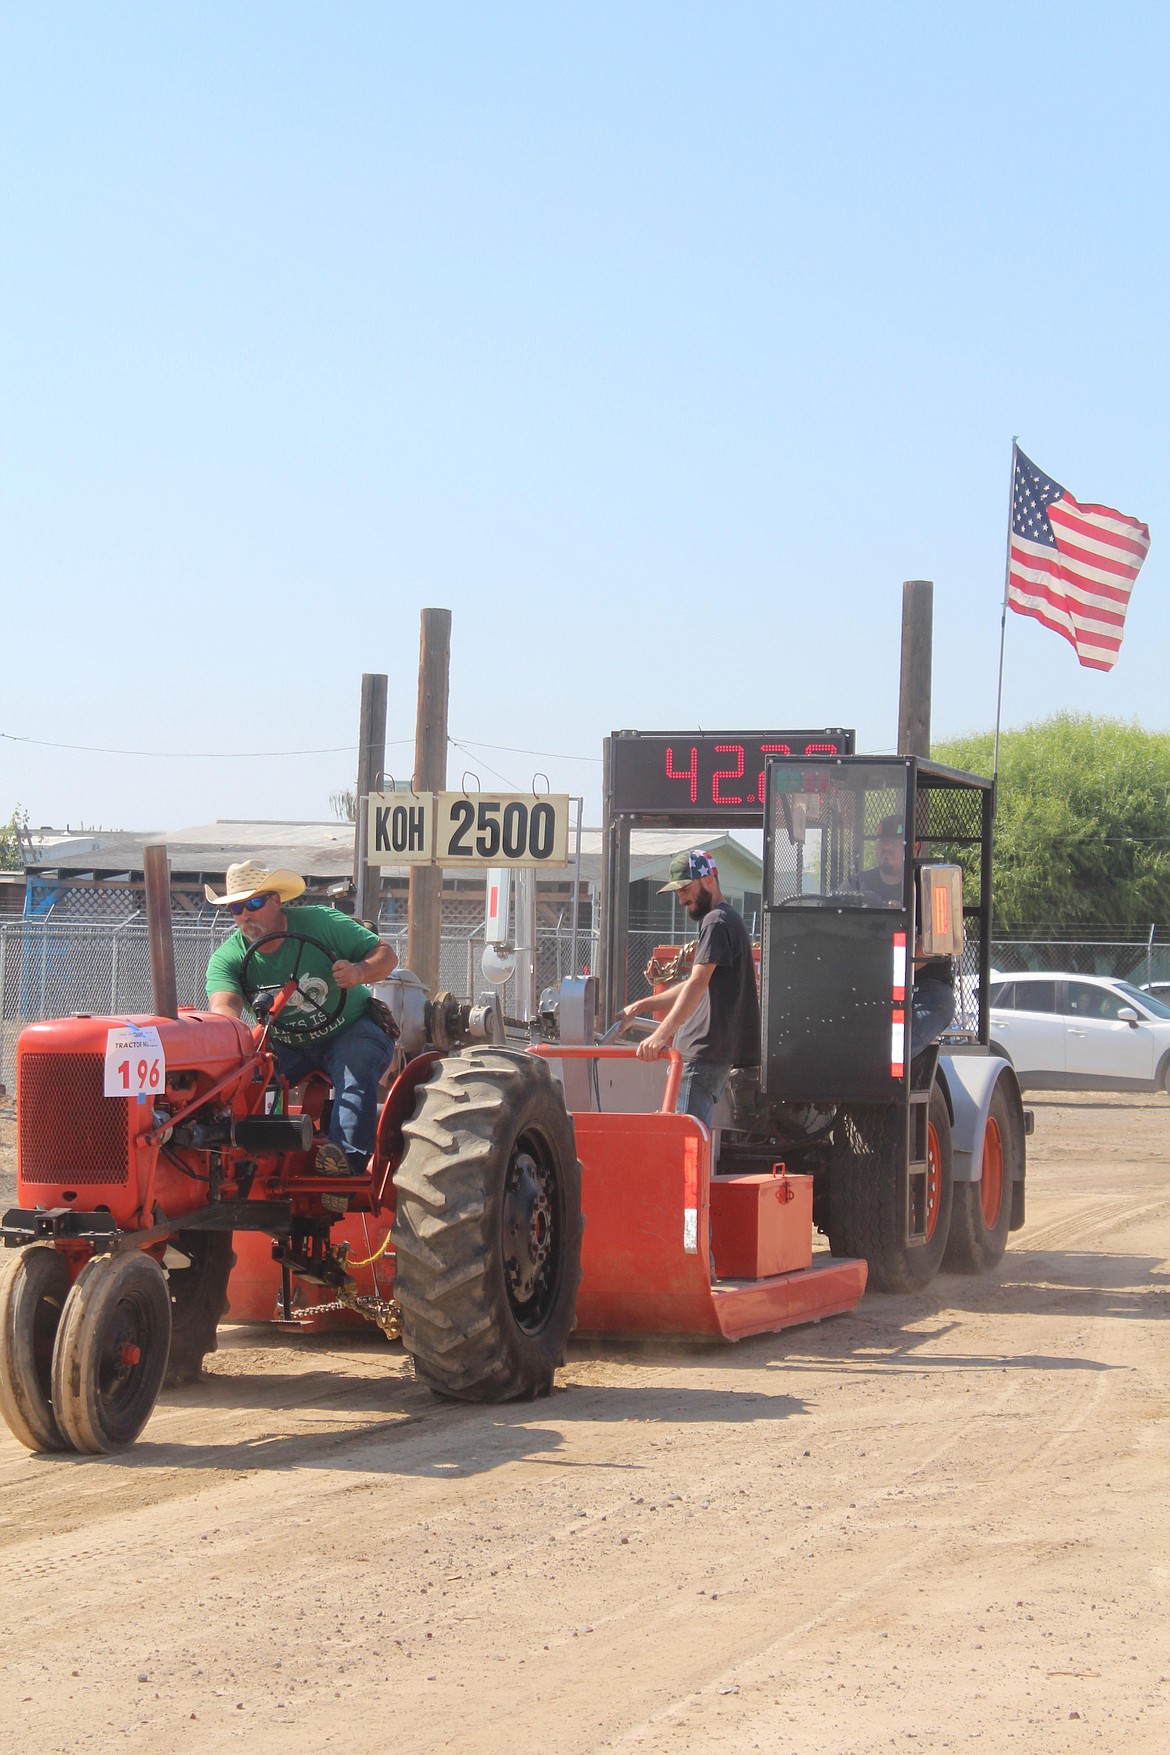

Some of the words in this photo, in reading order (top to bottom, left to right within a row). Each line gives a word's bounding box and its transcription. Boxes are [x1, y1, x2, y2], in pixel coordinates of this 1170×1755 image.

[375, 805, 425, 852] KOH
[447, 799, 556, 860] 2500
[309, 1011, 328, 1026] IS
[309, 1016, 346, 1040] ROLL
[115, 1041, 142, 1049] TRACTOR
[118, 1058, 160, 1090] 196
